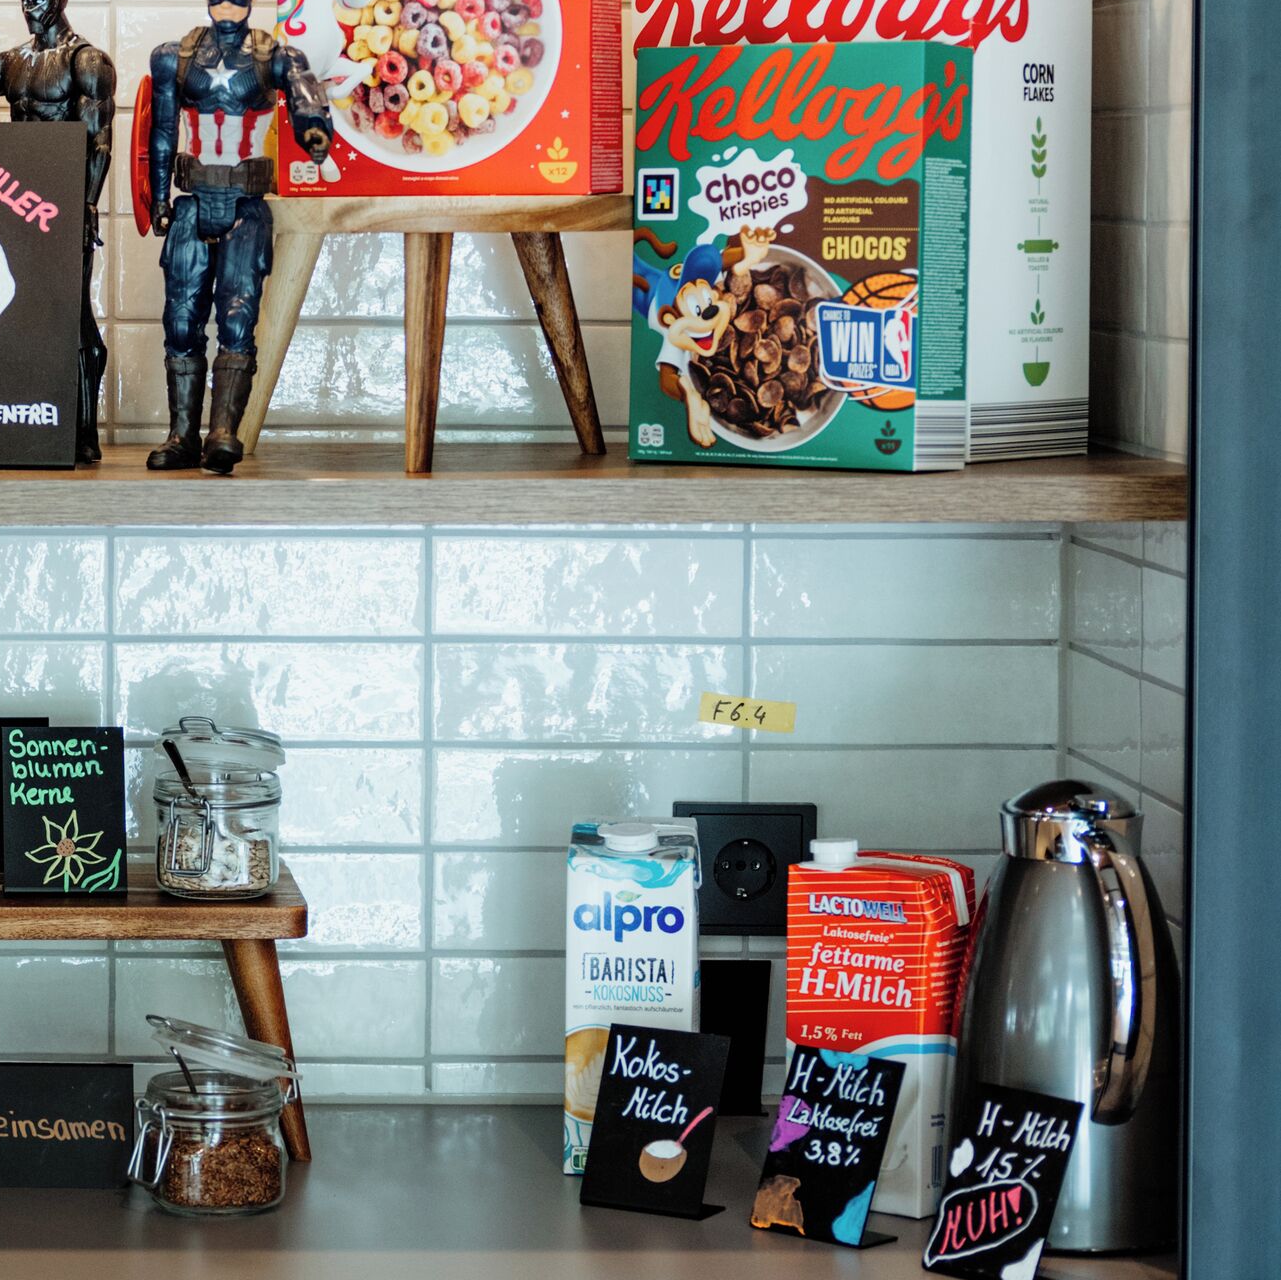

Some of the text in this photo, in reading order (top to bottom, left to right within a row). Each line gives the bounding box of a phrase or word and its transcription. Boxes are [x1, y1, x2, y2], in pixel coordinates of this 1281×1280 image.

[1023, 63, 1055, 84] CORN
[1023, 87, 1055, 102] FLAKES
[635, 43, 969, 180] Kellogg's
[705, 166, 795, 203] choco
[719, 190, 789, 223] krispies
[830, 322, 874, 363] WIN
[9, 728, 108, 758] Sonnen-
[12, 760, 103, 779] blumen
[10, 783, 75, 806] Kerne
[573, 891, 685, 943] alpro
[808, 893, 907, 924] LACTOWELL
[589, 957, 668, 984] BARISTA
[808, 942, 905, 973] fettarme
[593, 984, 664, 1003] KOKOSNUSS
[799, 967, 912, 1008] H-Milch
[841, 1029, 863, 1040] Fett
[610, 1035, 692, 1083] Kokos-
[622, 1086, 688, 1125] Milch
[786, 1098, 884, 1142] Laktosefrei
[940, 1185, 1023, 1255] MUH!
